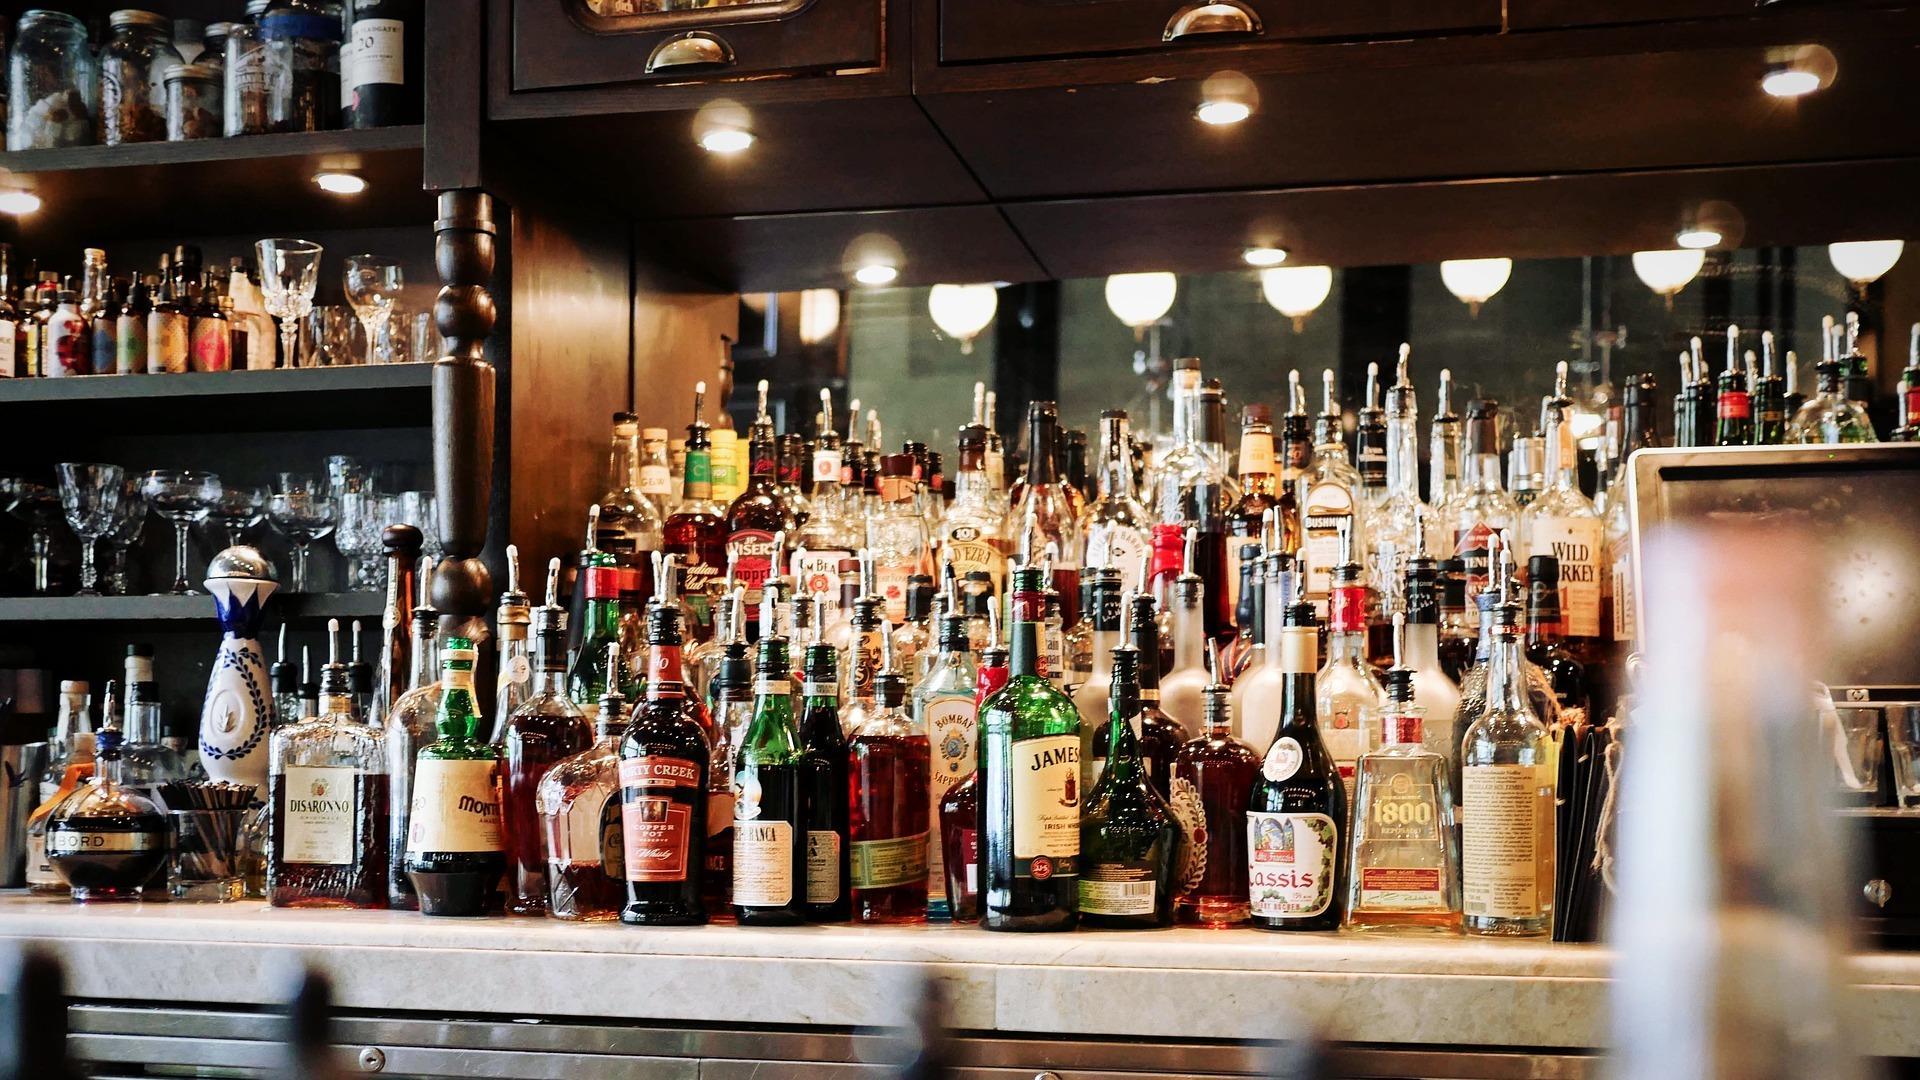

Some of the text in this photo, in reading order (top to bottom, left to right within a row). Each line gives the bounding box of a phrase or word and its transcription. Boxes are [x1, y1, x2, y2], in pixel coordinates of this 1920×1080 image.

[1551, 541, 1589, 562] WILD
[816, 558, 837, 575] BEA
[1561, 564, 1596, 583] RKEY
[934, 714, 975, 732] BOMBAY
[1030, 746, 1080, 772] JAMES
[653, 764, 695, 779] CREEK
[289, 799, 350, 814] DISARONNO
[1373, 800, 1431, 825] 1800
[632, 824, 675, 832] COPPER
